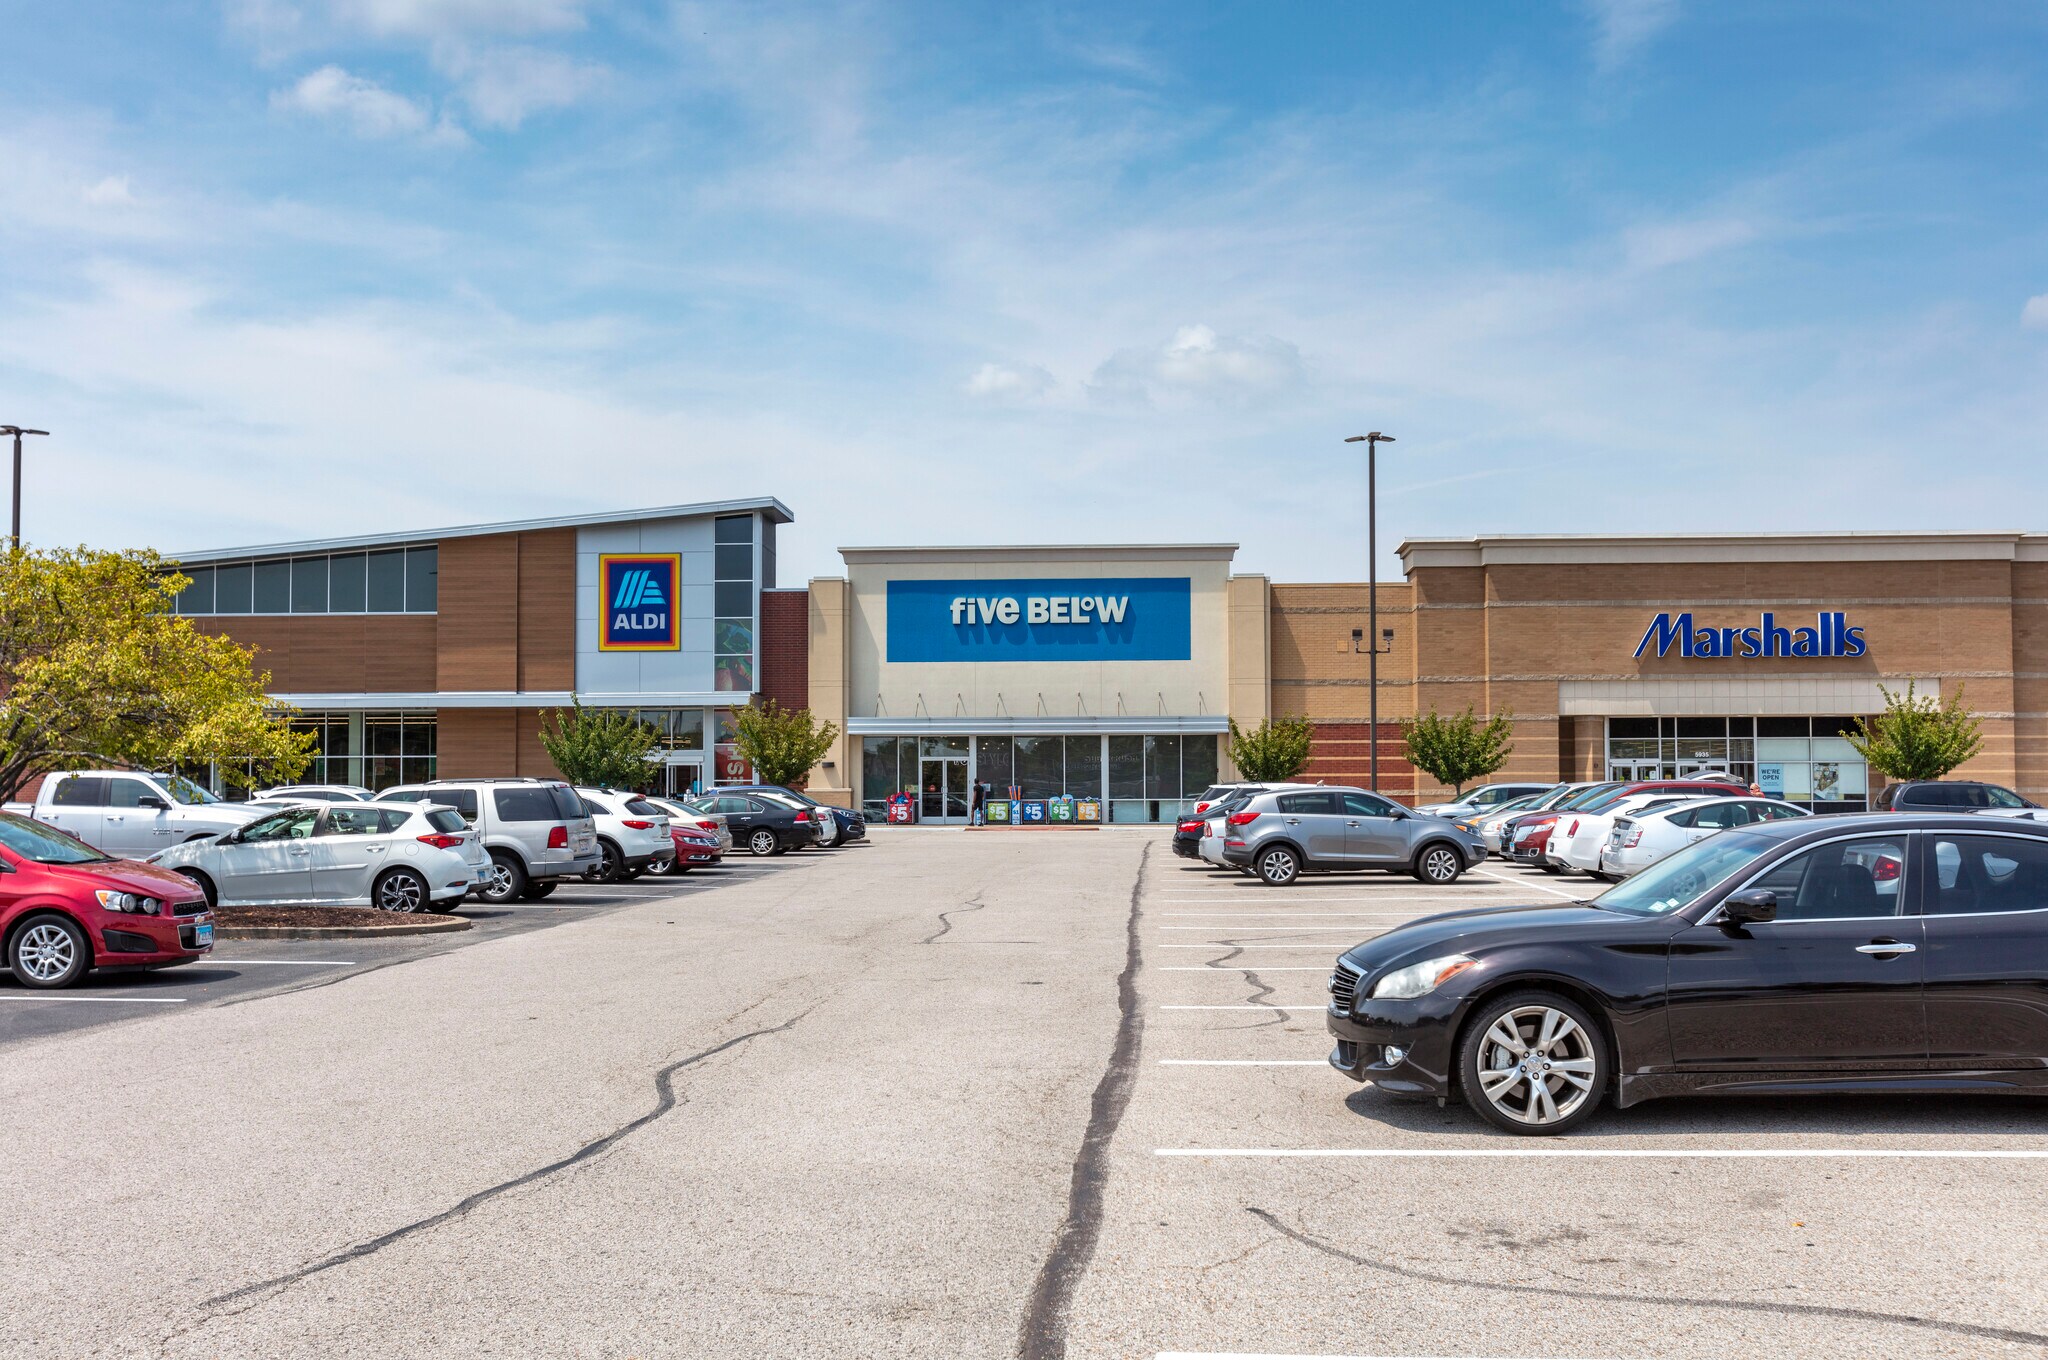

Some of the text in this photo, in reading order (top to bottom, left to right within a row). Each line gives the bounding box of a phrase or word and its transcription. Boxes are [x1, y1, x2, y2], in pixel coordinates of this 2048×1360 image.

[950, 596, 1129, 625] five BELOW
[614, 613, 665, 630] ALDI
[1632, 612, 1866, 658] Marshalls
[891, 806, 908, 821] $5
[989, 805, 1006, 820] $5
[1025, 806, 1042, 820] $5
[1053, 805, 1070, 820] $5
[1079, 805, 1096, 820] $5
